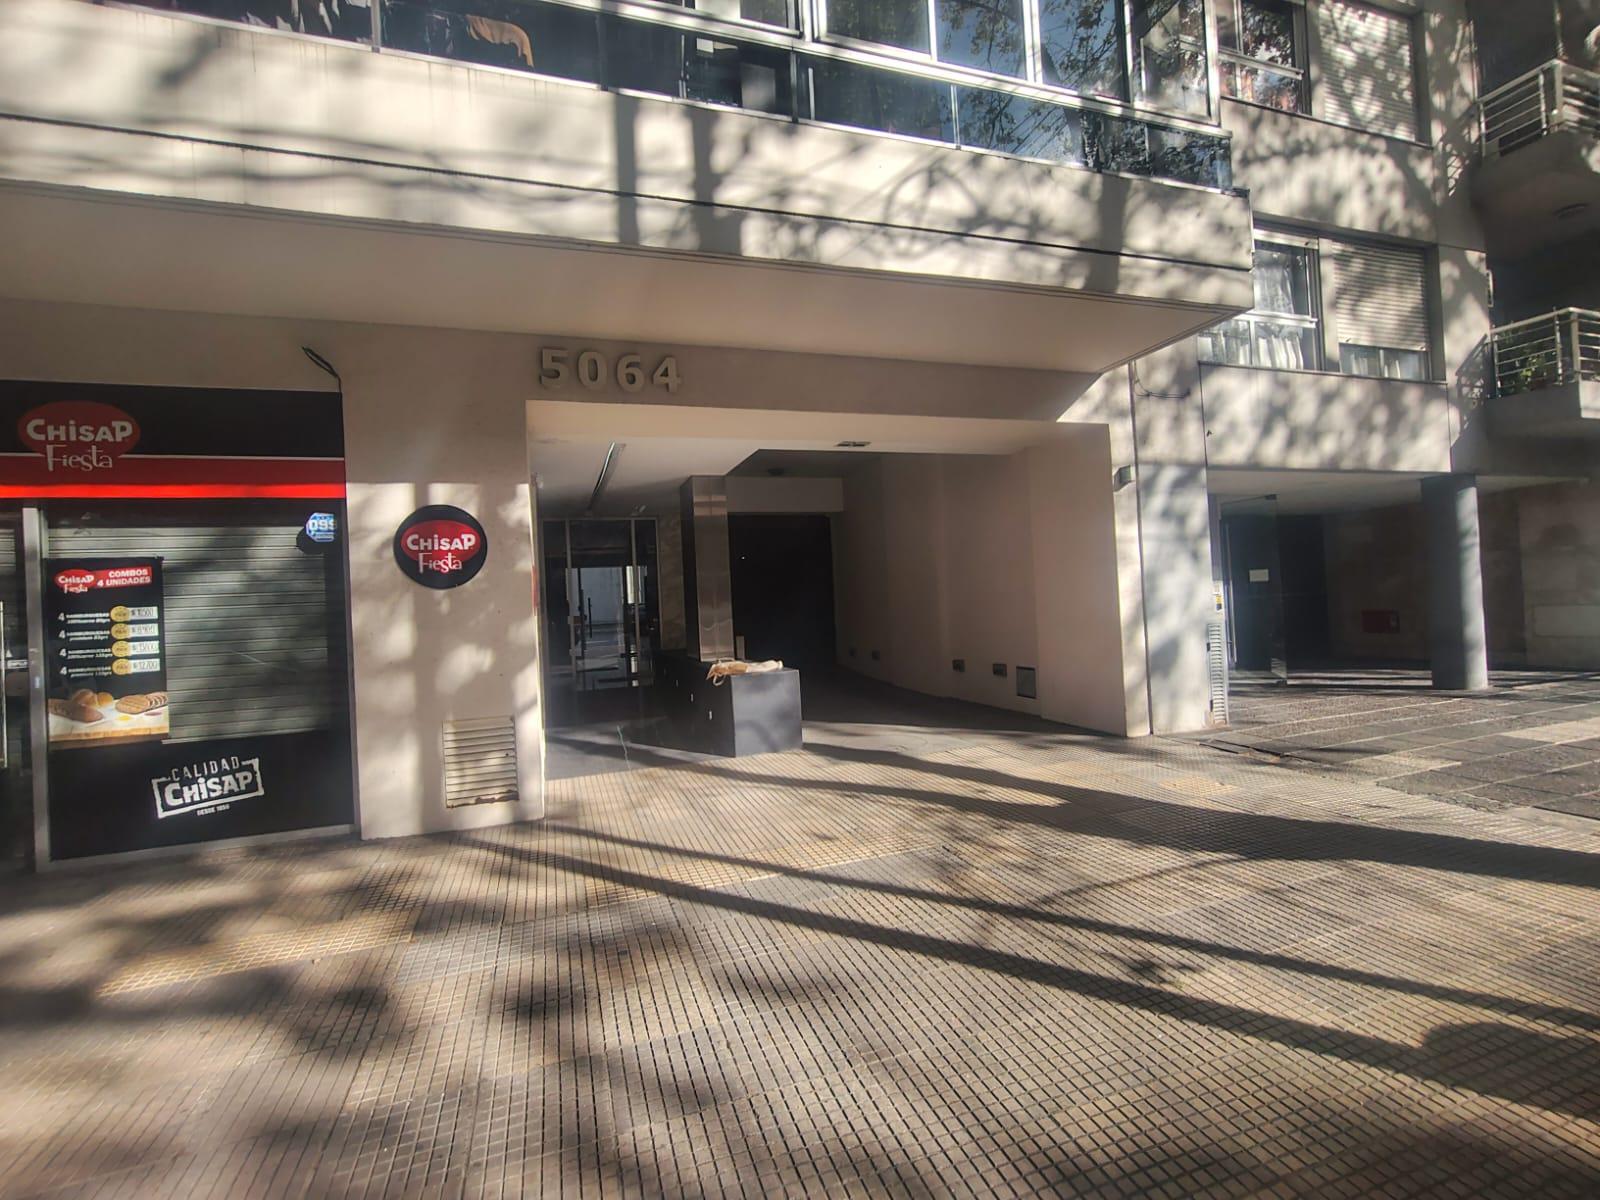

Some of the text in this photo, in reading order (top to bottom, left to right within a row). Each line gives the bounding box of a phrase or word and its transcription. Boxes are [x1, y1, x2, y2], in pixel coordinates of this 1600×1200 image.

[540, 347, 682, 393] 5064
[46, 444, 113, 472] Fiesta
[418, 552, 463, 574] Fiesta
[108, 568, 148, 578] COMBOS
[105, 576, 151, 586] UNIDADES
[58, 612, 65, 621] 4
[58, 630, 66, 639] 4
[59, 648, 67, 657] 4
[60, 666, 67, 675] 4
[171, 756, 241, 781] CALIDAD
